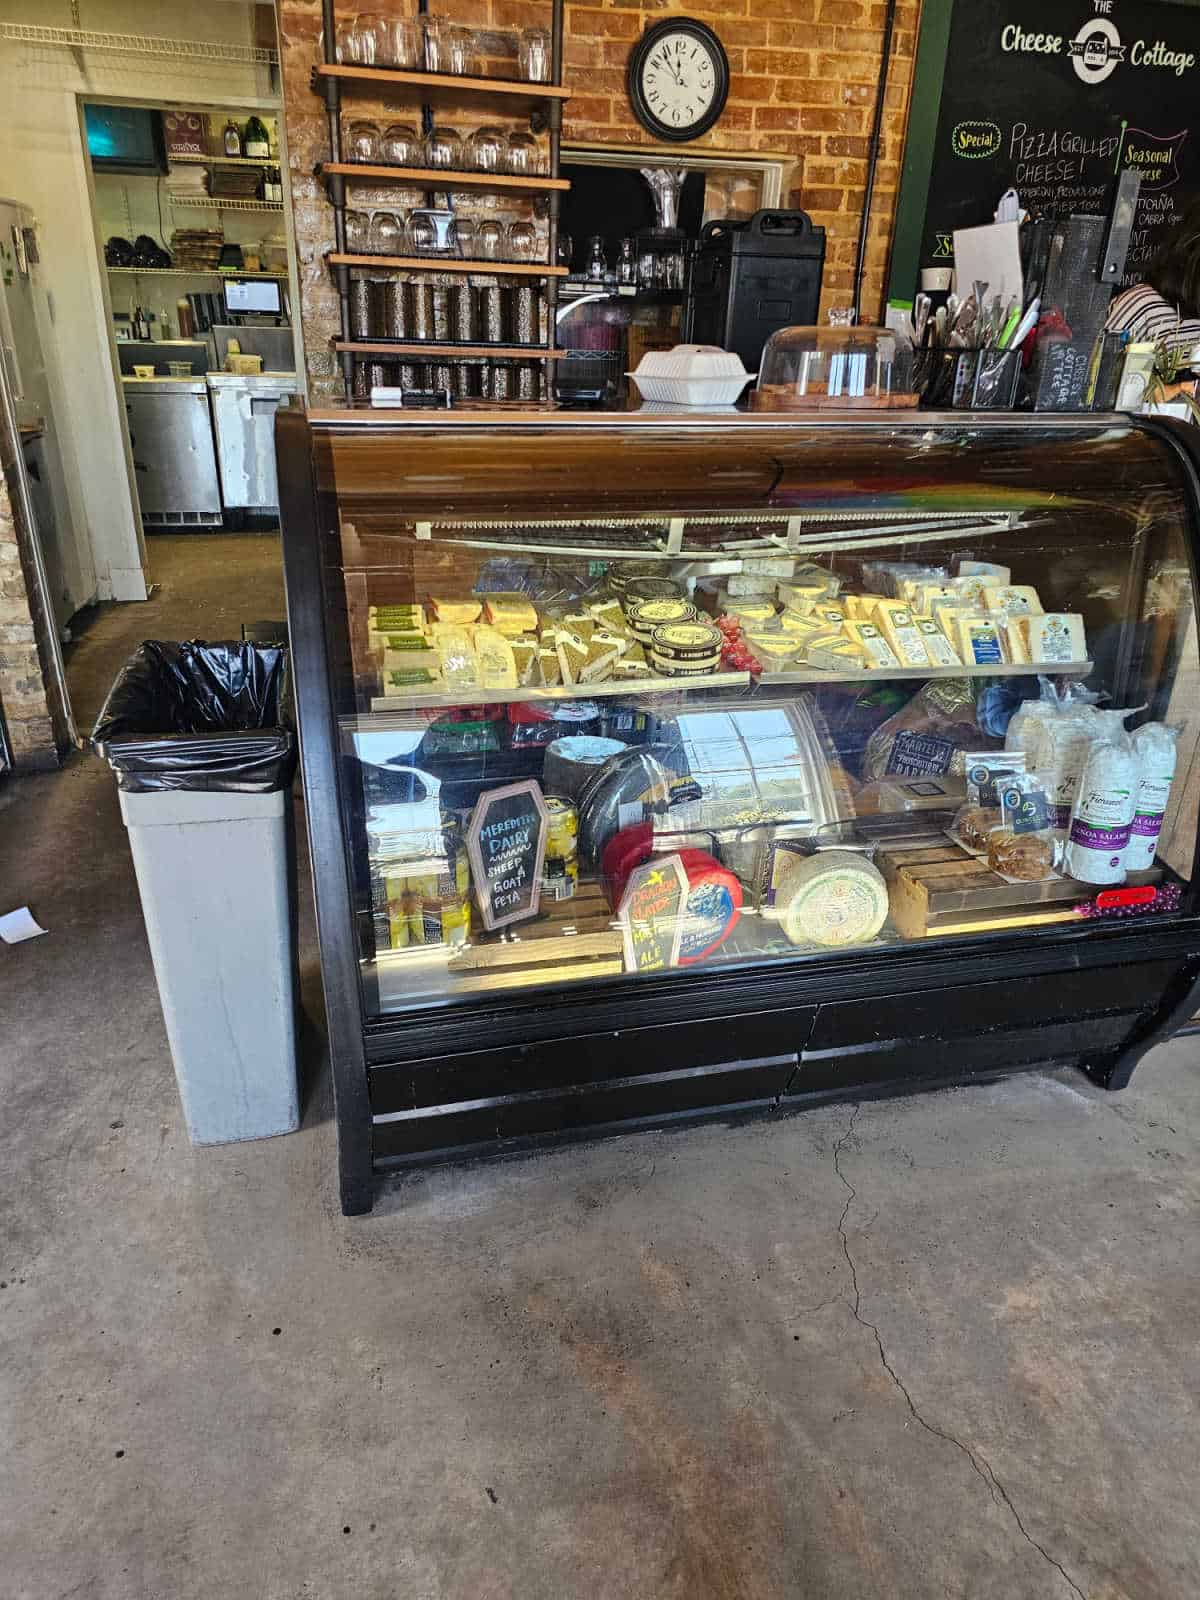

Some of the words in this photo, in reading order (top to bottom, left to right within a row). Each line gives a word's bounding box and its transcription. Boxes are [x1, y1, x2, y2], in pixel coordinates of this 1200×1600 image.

[1094, 0, 1112, 14] THE
[1001, 25, 1062, 54] Cheese
[1131, 40, 1195, 76] Cottage
[959, 130, 993, 149] Special
[1010, 122, 1057, 159] PIZZA
[1061, 131, 1118, 158] GRILLED
[1125, 144, 1173, 164] Seasonal
[481, 814, 536, 841] MEREDITH
[490, 827, 530, 854] DAIRY
[487, 857, 523, 878] SHEEP
[494, 876, 522, 894] GOAT
[494, 890, 521, 909] FETA
